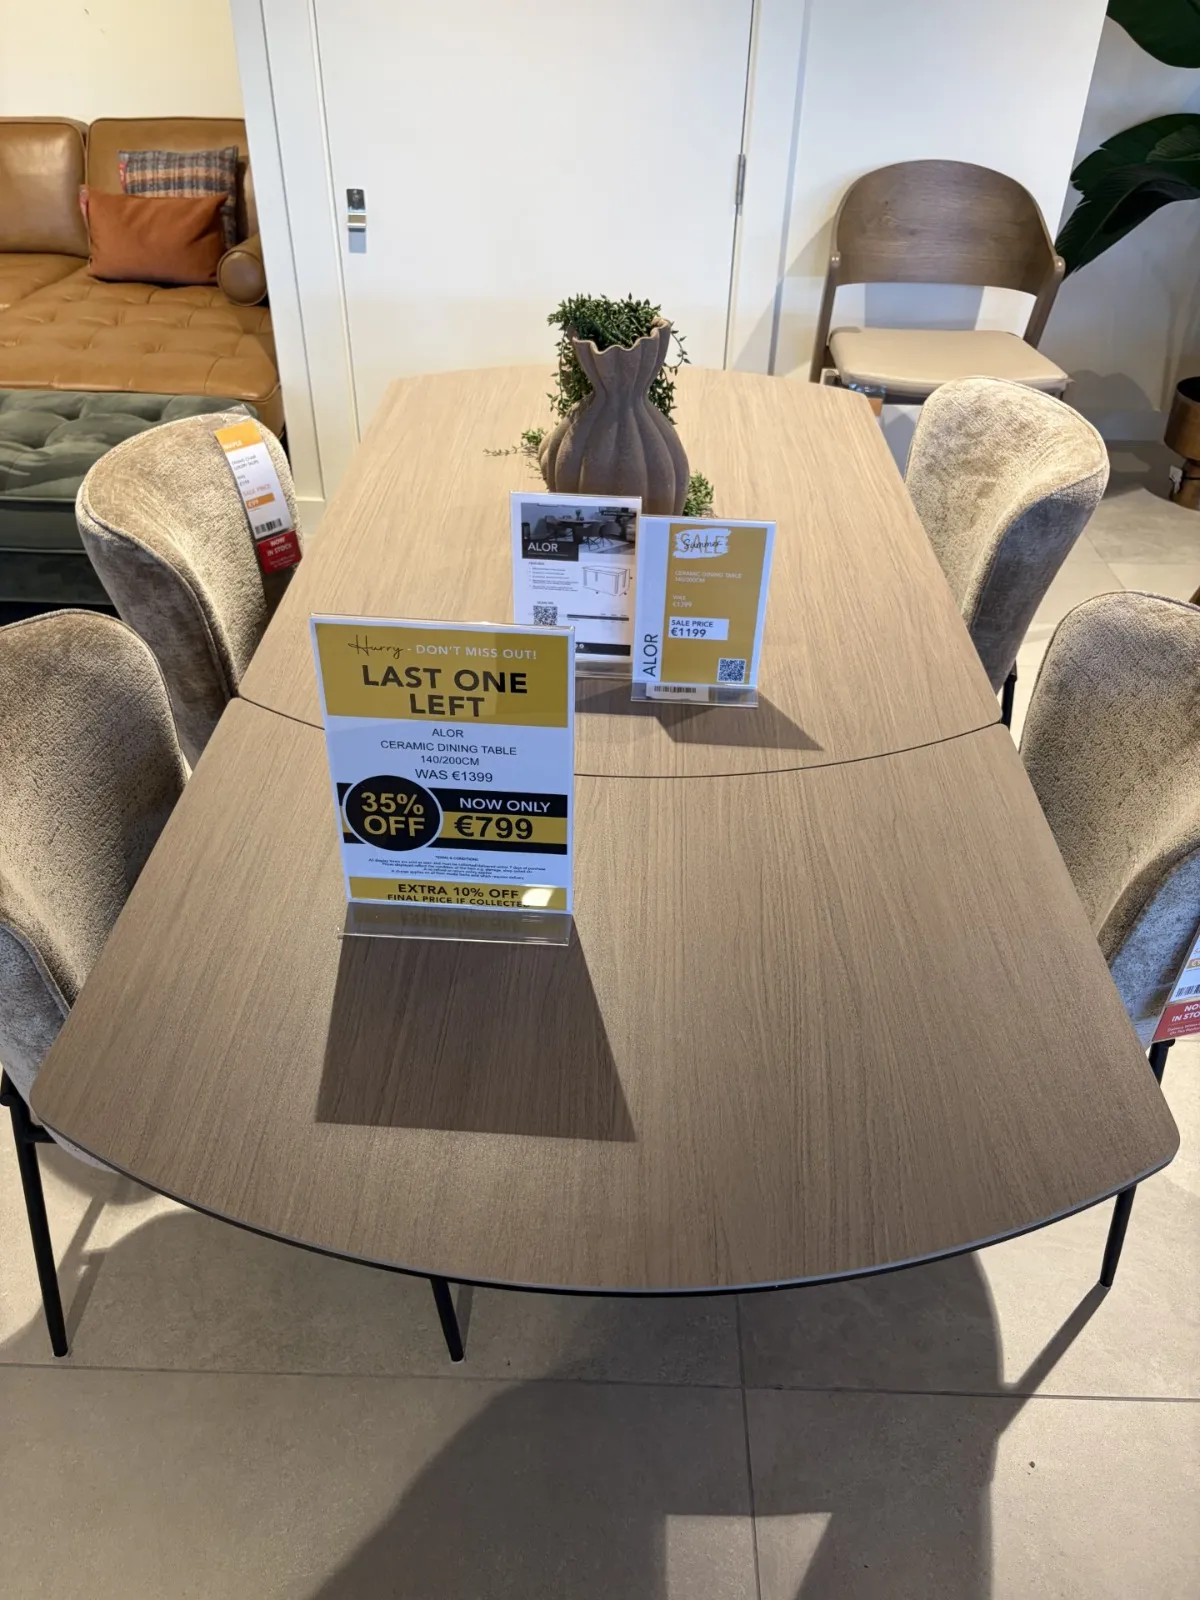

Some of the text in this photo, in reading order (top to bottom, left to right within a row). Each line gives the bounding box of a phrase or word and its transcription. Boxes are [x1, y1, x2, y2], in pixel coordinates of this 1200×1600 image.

[528, 541, 558, 552] ALOR
[670, 627, 707, 638] €1199
[347, 634, 404, 659] Hurry
[416, 644, 462, 656] DON'T
[465, 647, 498, 658] MISS
[503, 649, 537, 660] OUT!
[642, 633, 659, 677] ALOR
[362, 665, 528, 694] LAST ONE
[410, 693, 485, 717] LEFT
[432, 728, 464, 738] ALOR
[380, 740, 517, 756] CERAMIC DINING TABLE
[421, 755, 480, 766] 140/200CM
[415, 768, 493, 783] WAS €1399
[361, 792, 424, 815] 35%
[459, 797, 551, 813] NOW ONLY
[363, 815, 425, 837] OFF
[454, 815, 533, 840] €799
[398, 883, 519, 899] EXTRA 10% OFF
[387, 894, 419, 902] FINAL
[422, 895, 453, 904] PRICE
[456, 897, 466, 905] IF
[1171, 1014, 1182, 1023] IN
